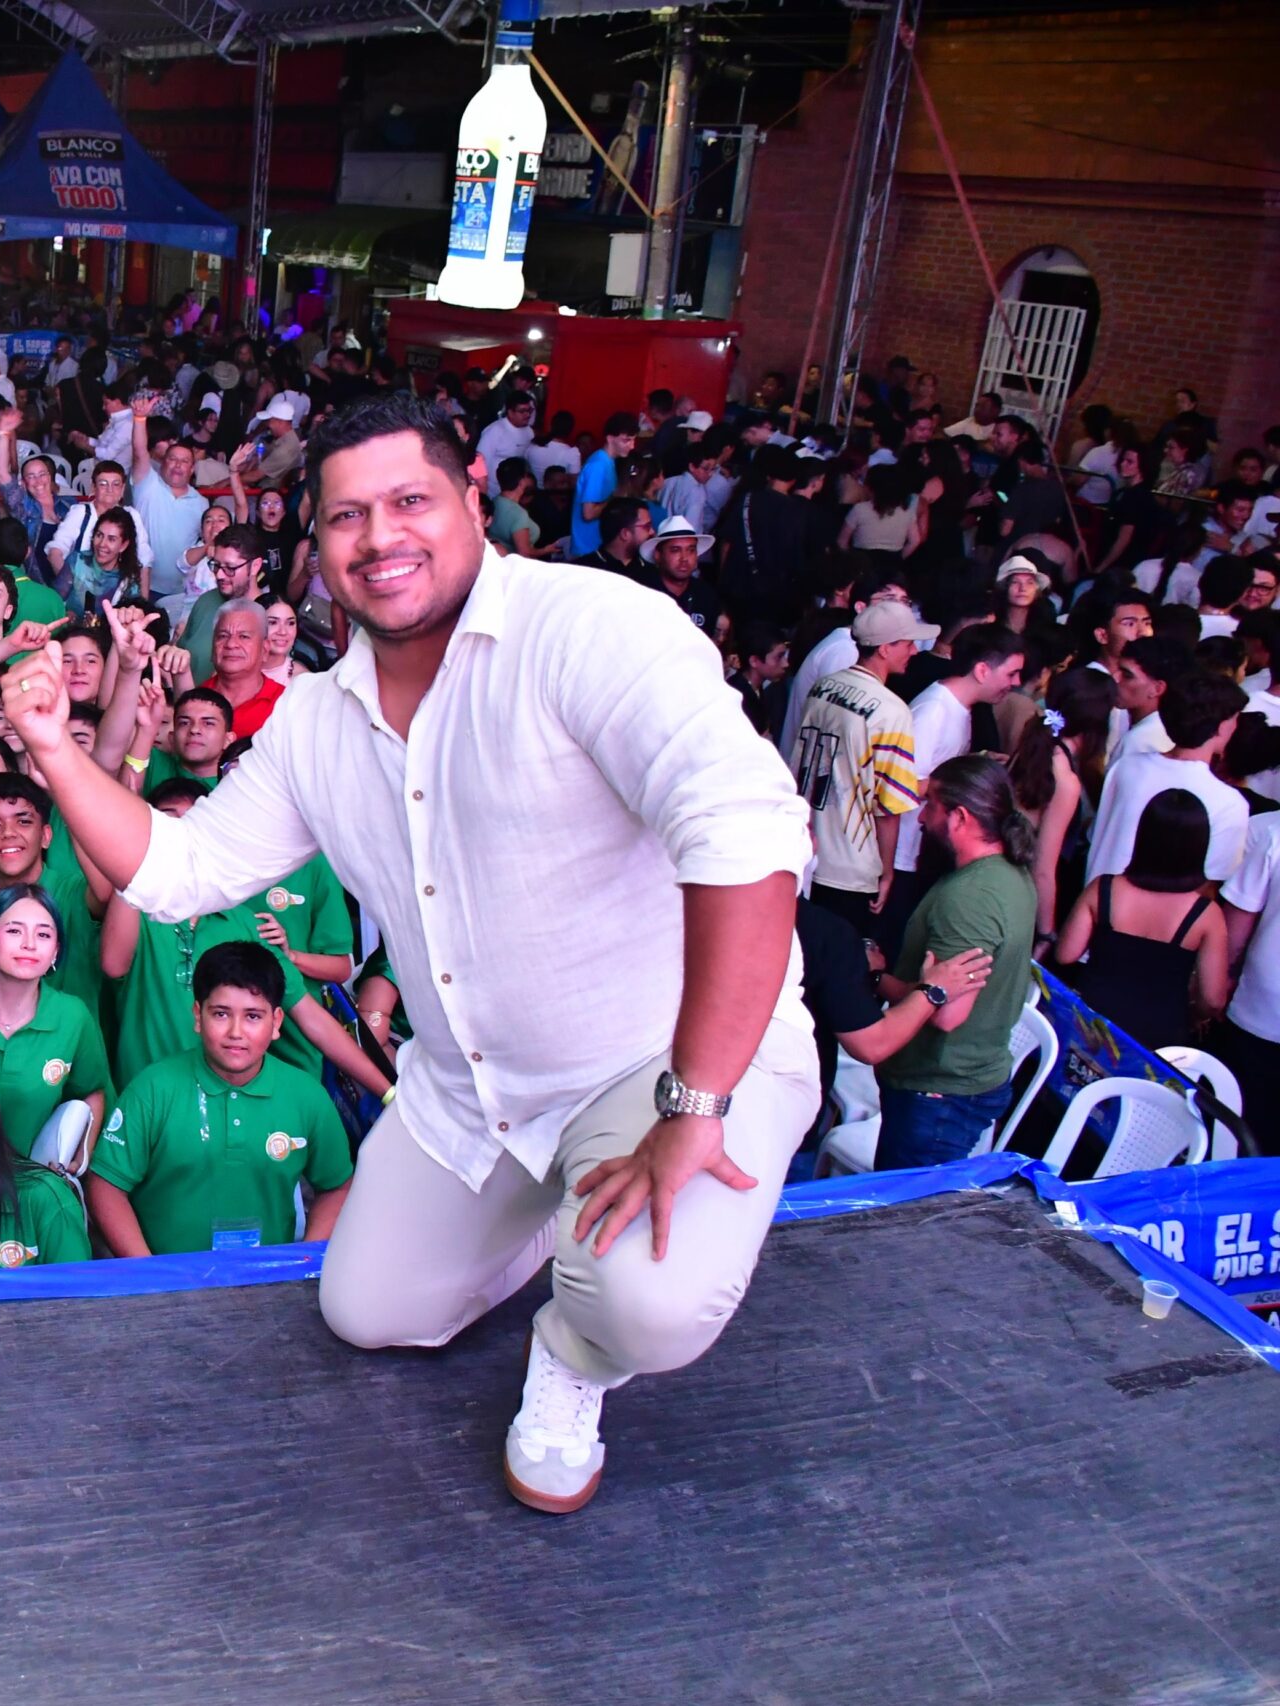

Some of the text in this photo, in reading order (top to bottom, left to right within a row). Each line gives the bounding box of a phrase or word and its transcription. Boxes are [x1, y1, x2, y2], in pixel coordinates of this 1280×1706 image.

[46, 138, 117, 153] BLANCO
[85, 165, 123, 186] CON
[51, 184, 127, 212] TODO!
[799, 725, 840, 811] 11
[1215, 1212, 1261, 1257] EL
[1212, 1252, 1265, 1287] que
